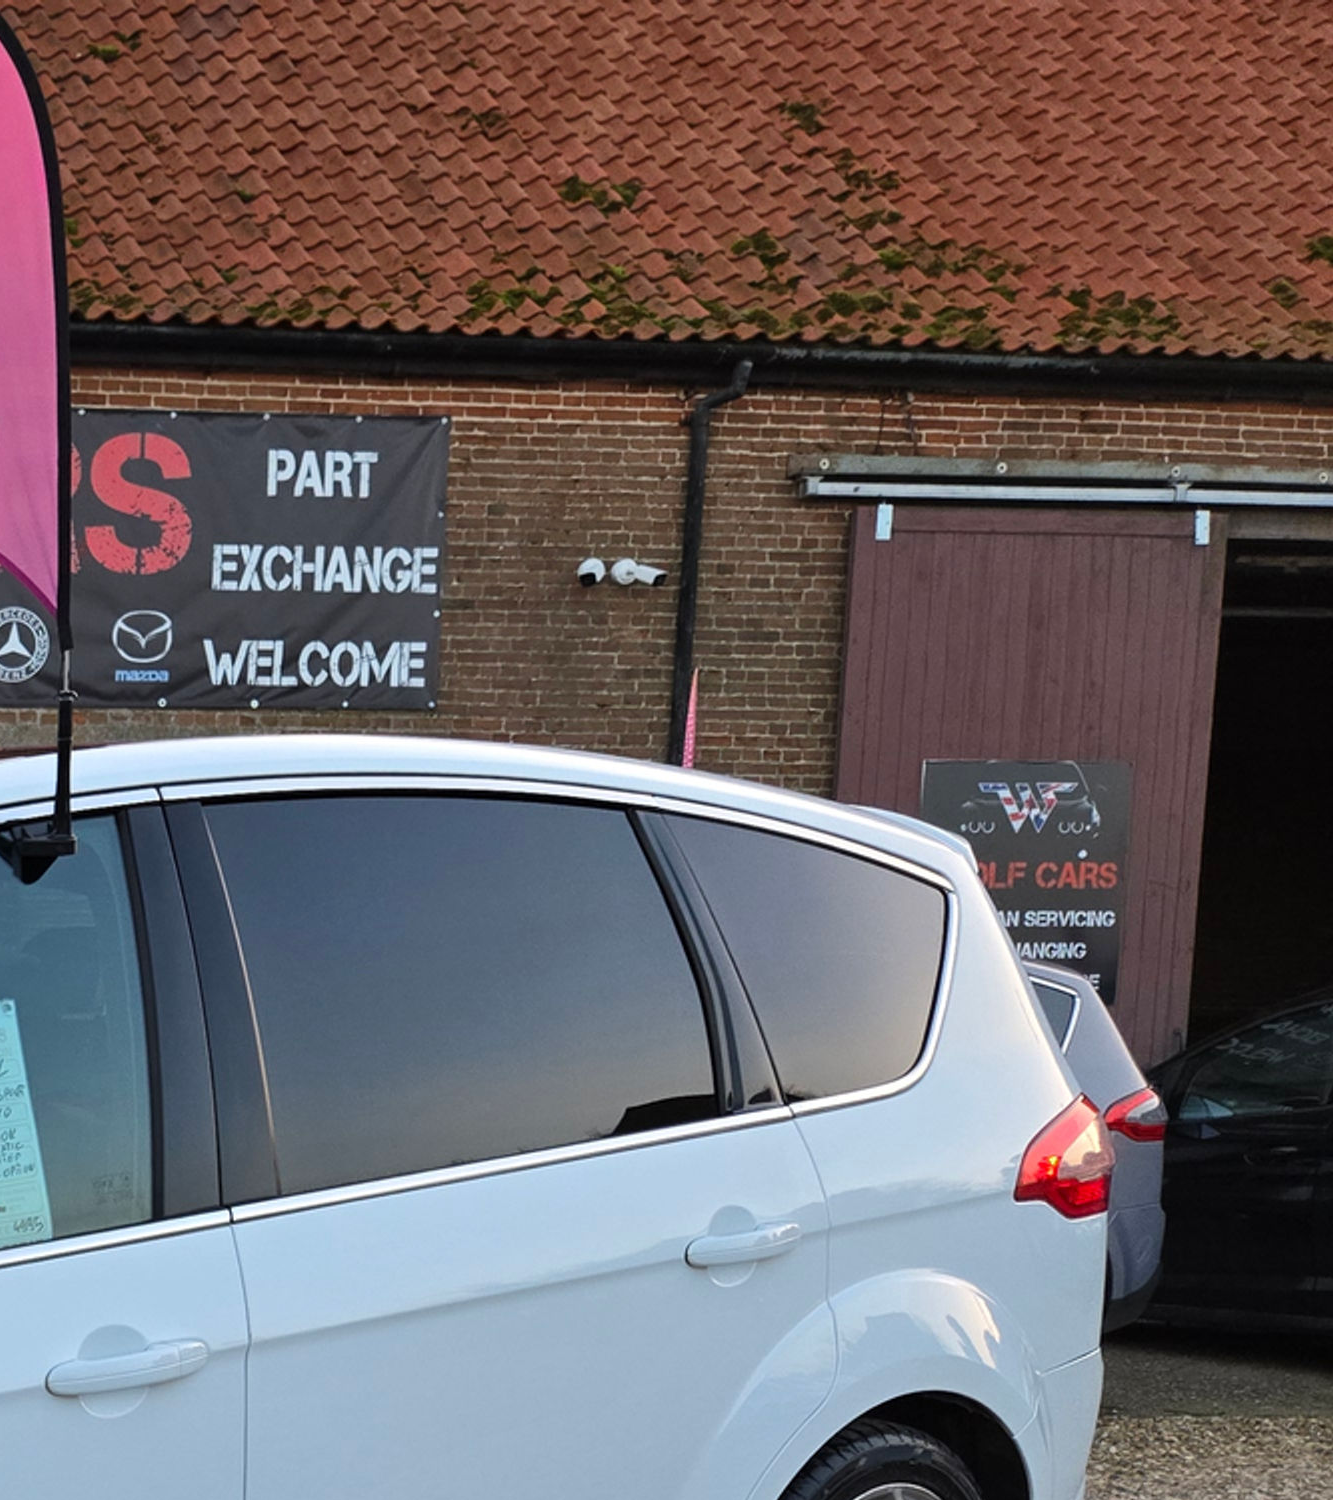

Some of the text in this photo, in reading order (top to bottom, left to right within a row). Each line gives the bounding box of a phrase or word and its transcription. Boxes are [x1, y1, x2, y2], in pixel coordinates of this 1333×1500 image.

[266, 449, 379, 499] PART
[211, 544, 439, 594] EXCHANGE
[114, 668, 170, 683] mazda
[203, 639, 427, 688] WELCOME
[978, 861, 1118, 889] LF CARS
[1023, 910, 1116, 928] SERVICING
[1017, 942, 1087, 960] ANGING
